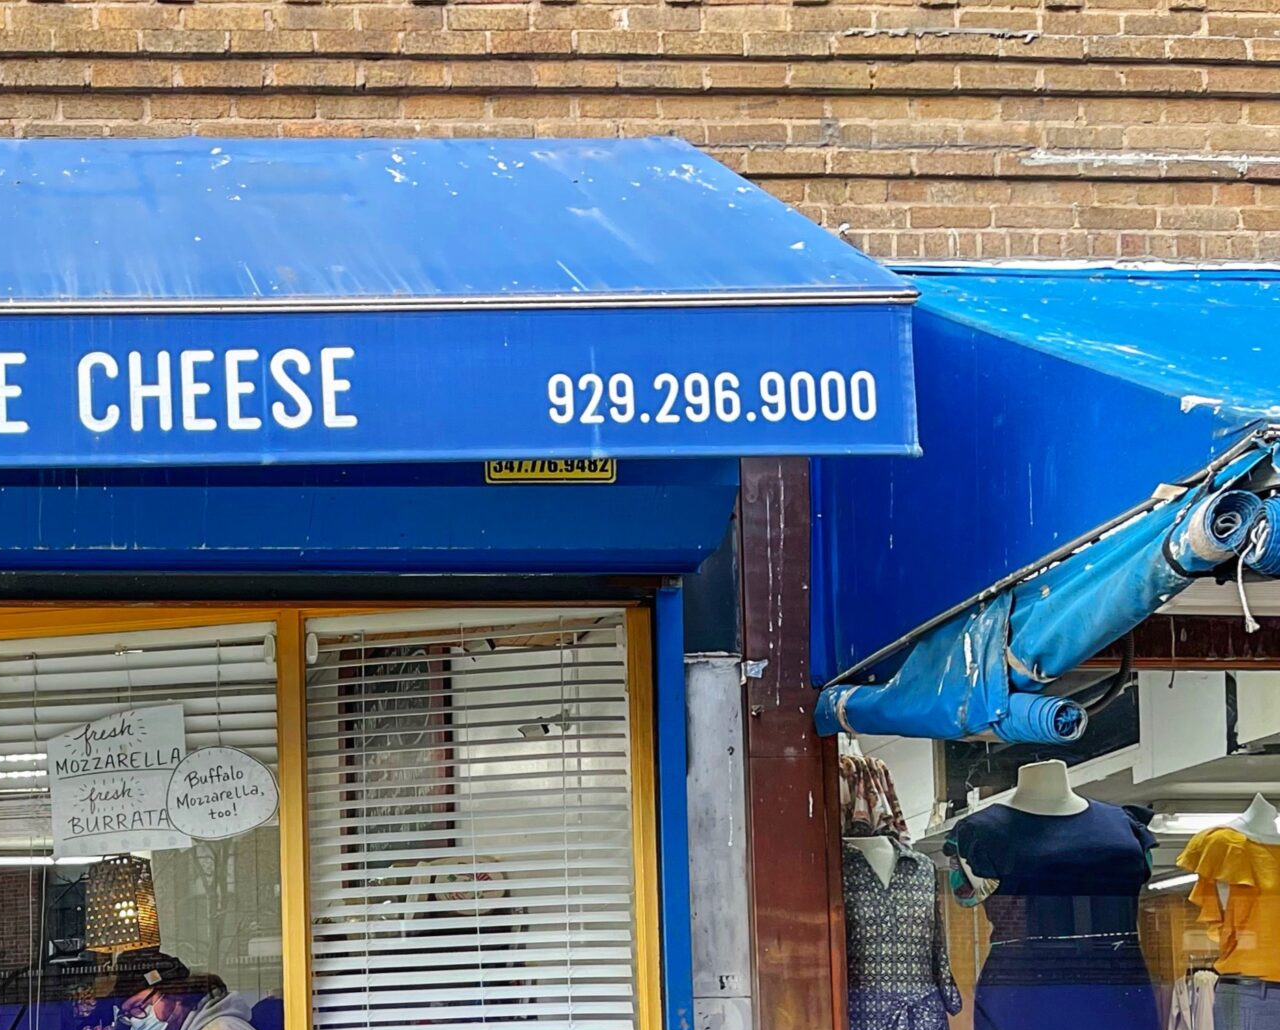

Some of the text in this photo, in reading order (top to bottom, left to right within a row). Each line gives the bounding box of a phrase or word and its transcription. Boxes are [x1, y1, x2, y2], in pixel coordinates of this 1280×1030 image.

[78, 346, 358, 432] CHEESE
[547, 370, 877, 424] 929.296.9000
[74, 718, 134, 756] fresh
[56, 748, 183, 774] MOZZARELLA
[184, 765, 244, 789] Buffalo
[80, 782, 133, 813] fresh
[209, 804, 237, 819] too!
[68, 808, 170, 835] BURRATA
